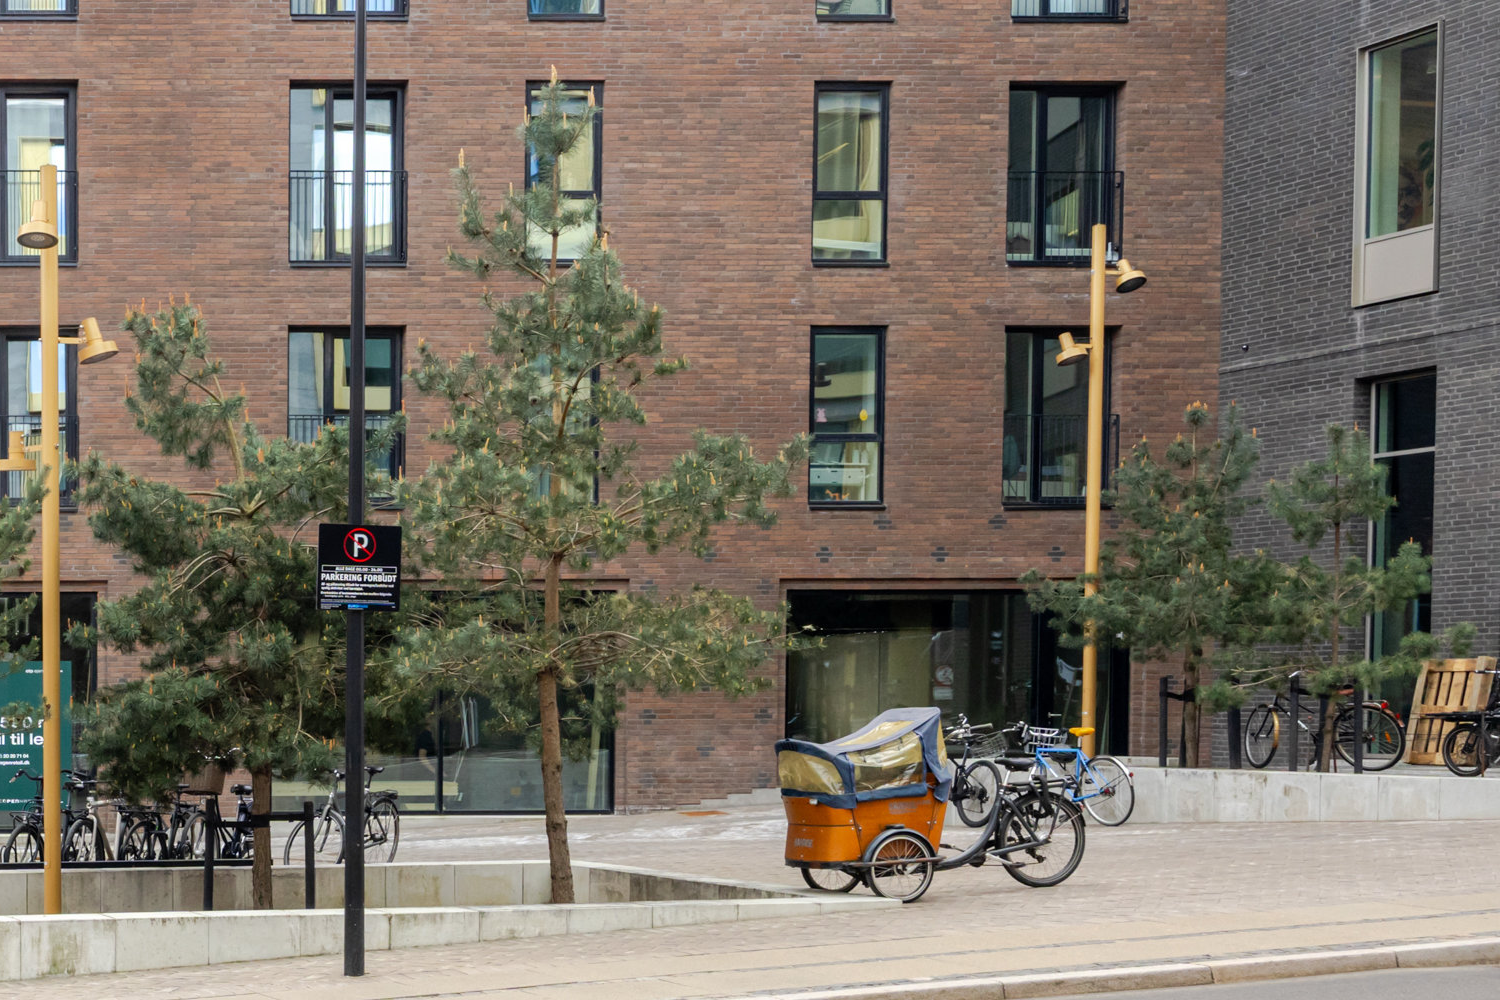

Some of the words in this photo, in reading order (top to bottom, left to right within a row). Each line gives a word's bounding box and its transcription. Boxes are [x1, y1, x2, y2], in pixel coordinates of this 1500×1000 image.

[321, 573, 362, 581] PARKERING
[363, 574, 397, 583] FORBUDT
[9, 732, 25, 746] til
[29, 732, 44, 747] le
